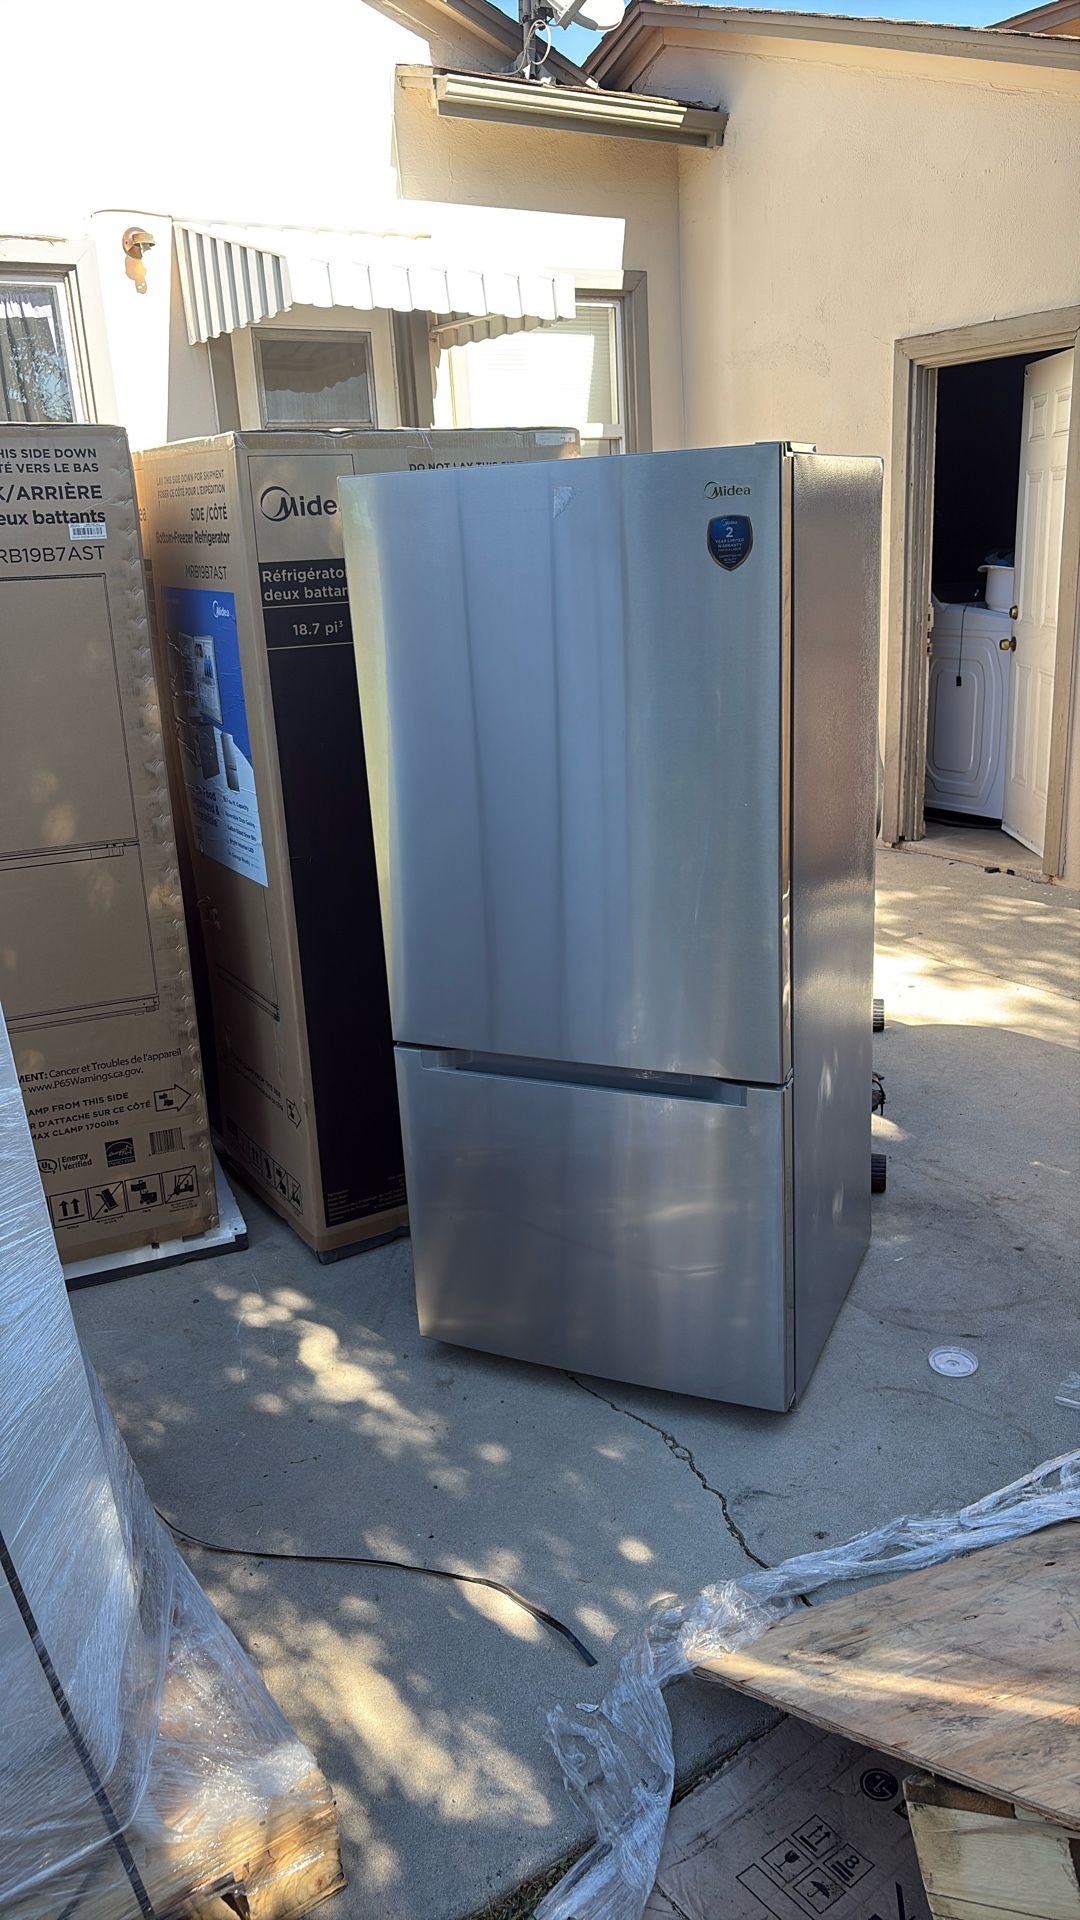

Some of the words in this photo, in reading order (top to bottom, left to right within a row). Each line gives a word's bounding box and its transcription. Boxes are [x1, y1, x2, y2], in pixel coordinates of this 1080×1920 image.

[0, 449, 17, 458] HIS
[21, 449, 51, 459] SIDE
[54, 448, 97, 458] DOWN
[16, 463, 51, 473] VERS
[54, 463, 70, 473] LE
[73, 463, 99, 473] BAS
[0, 482, 103, 503] K/ARRIÈRE
[704, 481, 751, 500] Midea
[260, 486, 340, 522] Mide
[0, 513, 29, 526] eux
[32, 509, 106, 525] battants
[194, 530, 230, 546] Refrigerator
[726, 526, 734, 538] 2
[0, 545, 105, 563] RB19B7AST
[185, 565, 227, 580] MRB19B7AST
[262, 567, 345, 583] Réfrigérato
[264, 588, 300, 601] deux
[292, 623, 320, 636] 18.7
[49, 1066, 80, 1078] Cancer
[81, 1064, 91, 1073] et
[91, 1058, 130, 1071] Troubles
[130, 1054, 143, 1064] de
[143, 1048, 182, 1062] l'appareil
[27, 1106, 50, 1117] AMP
[52, 1101, 81, 1113] FROM
[83, 1096, 105, 1106] THIS
[107, 1092, 129, 1101] SIDE
[39, 1112, 91, 1128] D'ATTACHE
[93, 1108, 111, 1118] SUR
[112, 1105, 125, 1114] CE
[127, 1099, 151, 1112] CÔTÉ
[53, 1125, 84, 1137] CLAMP
[85, 1119, 120, 1131] 1700lbs
[41, 1161, 54, 1171] UL
[61, 1152, 89, 1163] Energy
[63, 1159, 93, 1171] Verified
